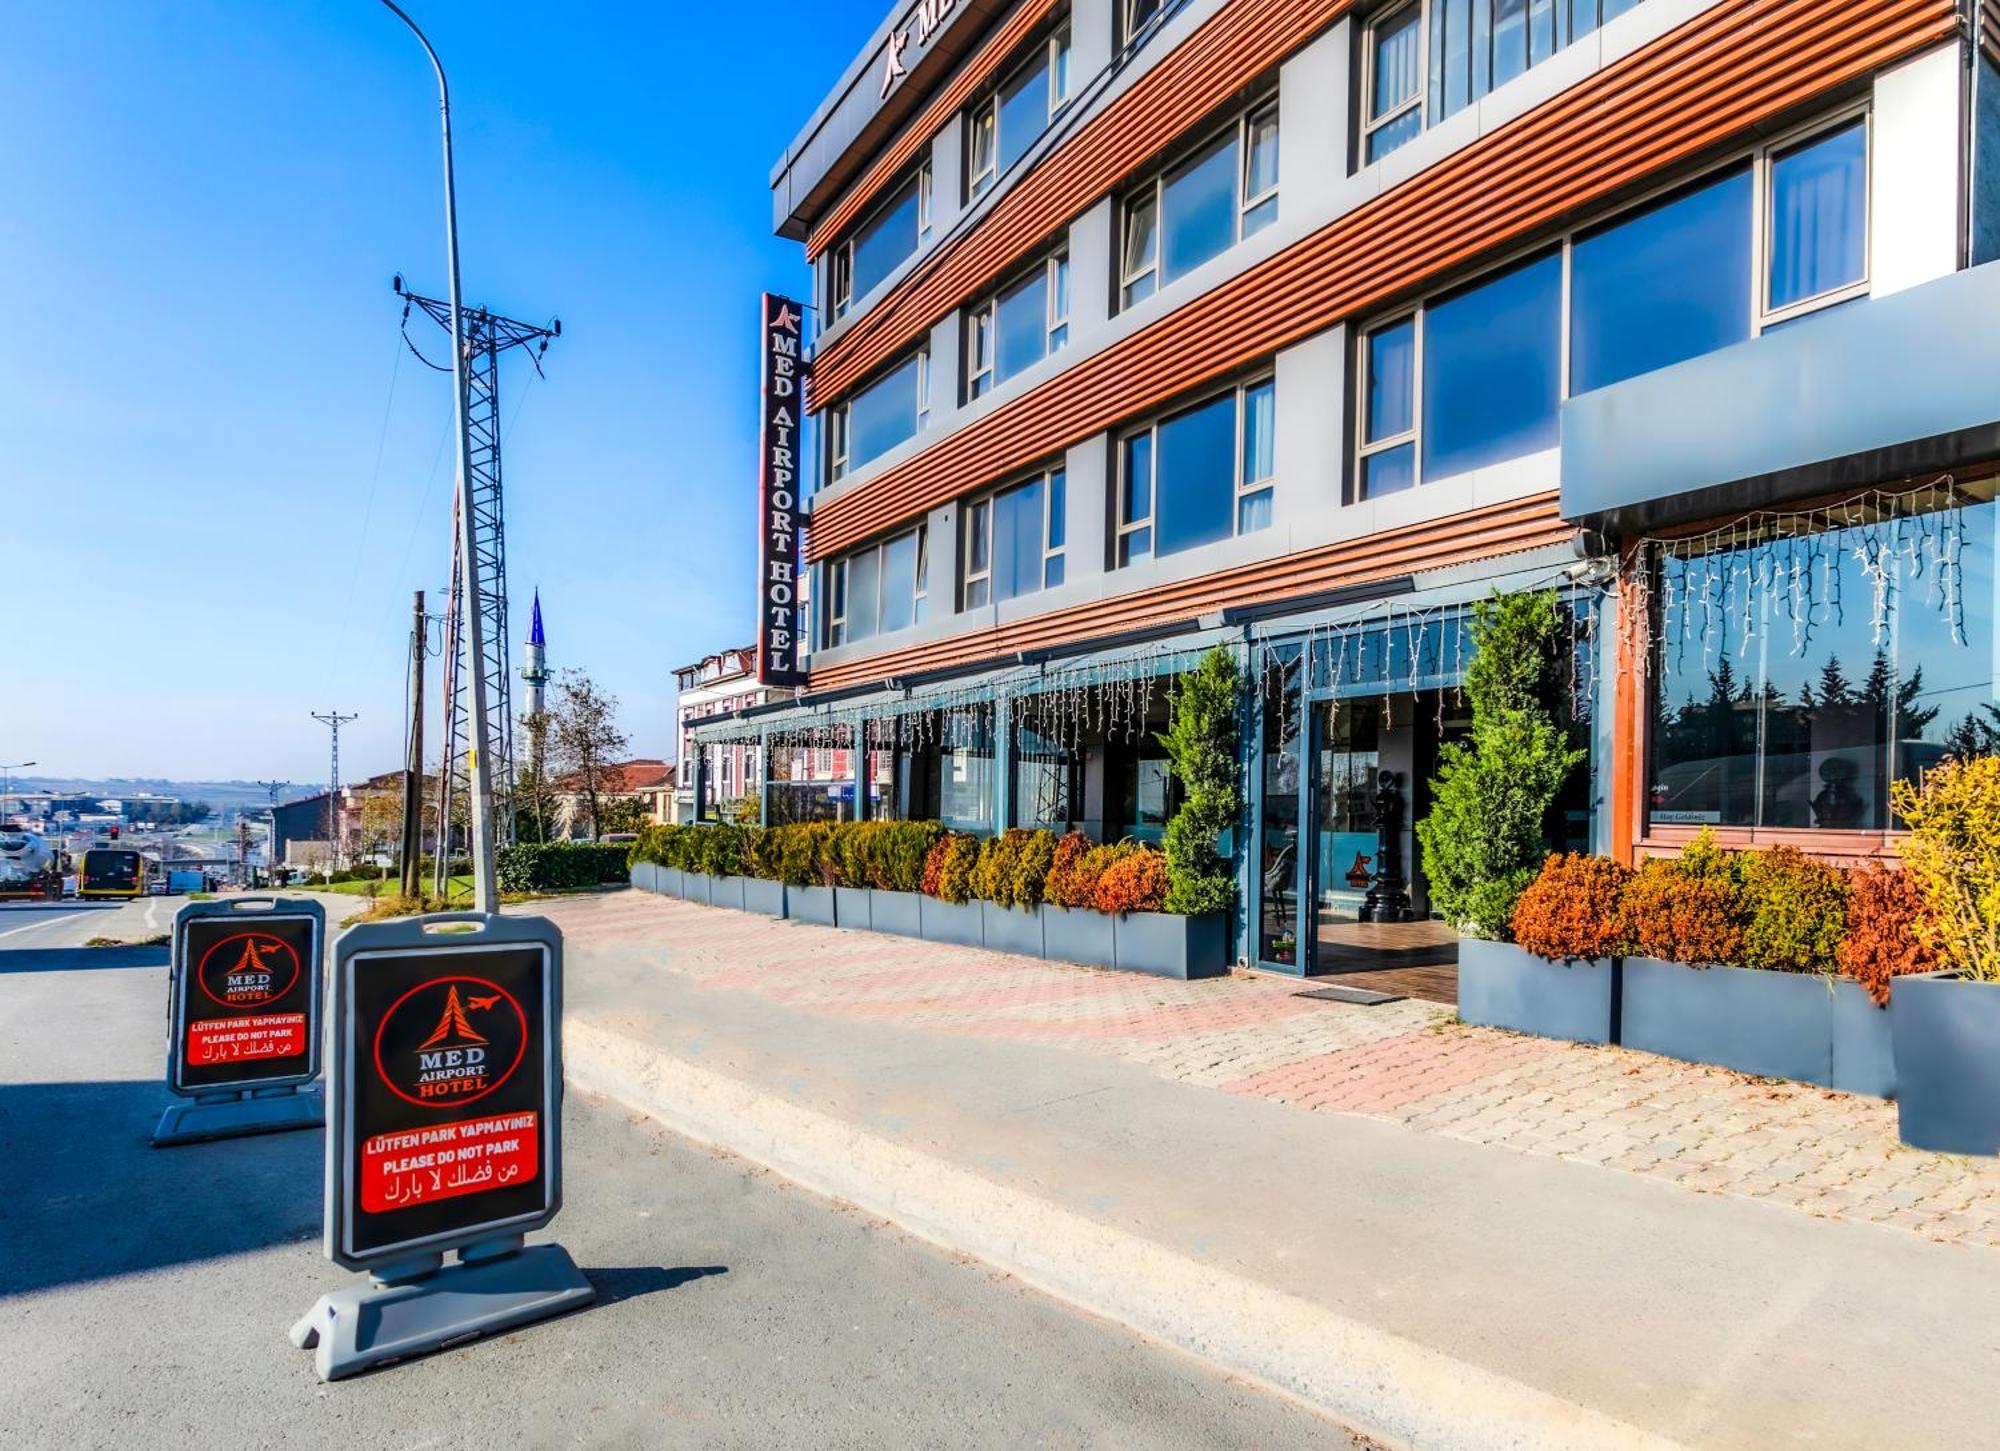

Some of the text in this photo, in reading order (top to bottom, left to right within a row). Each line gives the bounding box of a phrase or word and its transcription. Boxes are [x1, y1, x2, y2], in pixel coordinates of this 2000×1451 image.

[770, 333, 797, 672] MED AIRPORT HOTEL
[227, 974, 271, 986] MED
[227, 984, 271, 993] AIRPORT
[226, 992, 272, 1002] HOTEL
[191, 1015, 304, 1032] LÜTFEN PARK YAPMAYINIZ
[202, 1028, 293, 1044] PLEASE DO NOT PARK
[420, 1048, 485, 1070] MED
[419, 1065, 486, 1082] AIRPORT
[420, 1077, 488, 1098] HOTEL
[367, 1115, 535, 1155] LÜTFEN PARK YAPMAYINIZ
[383, 1139, 520, 1175] PLEASE DO NOT PARK
[384, 1159, 518, 1203] من فضلك لا بارك
